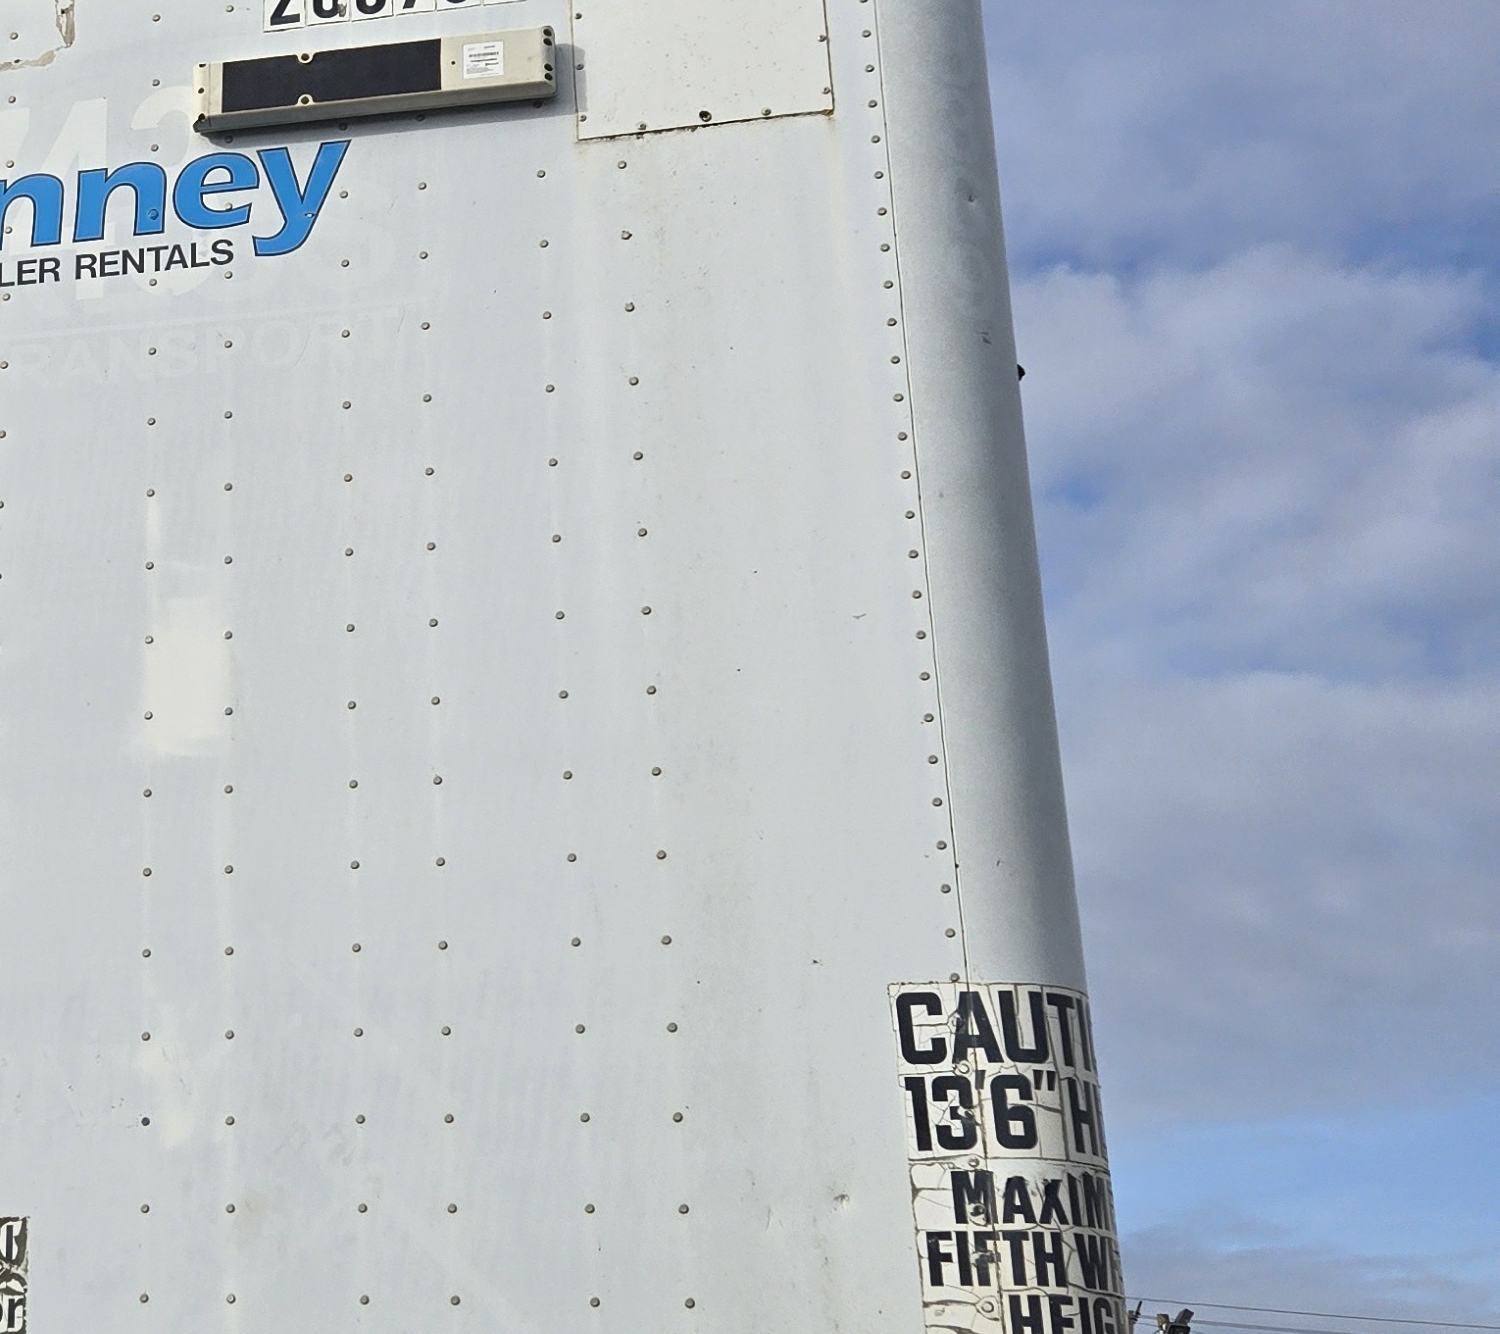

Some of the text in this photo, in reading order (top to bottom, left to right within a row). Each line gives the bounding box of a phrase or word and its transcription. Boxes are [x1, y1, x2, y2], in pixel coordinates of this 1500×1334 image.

[75, 239, 234, 280] RENTALS
[896, 991, 1097, 1073] CAUTI
[951, 1169, 1115, 1231] MAXIM
[926, 1231, 1069, 1288] FIFTH
